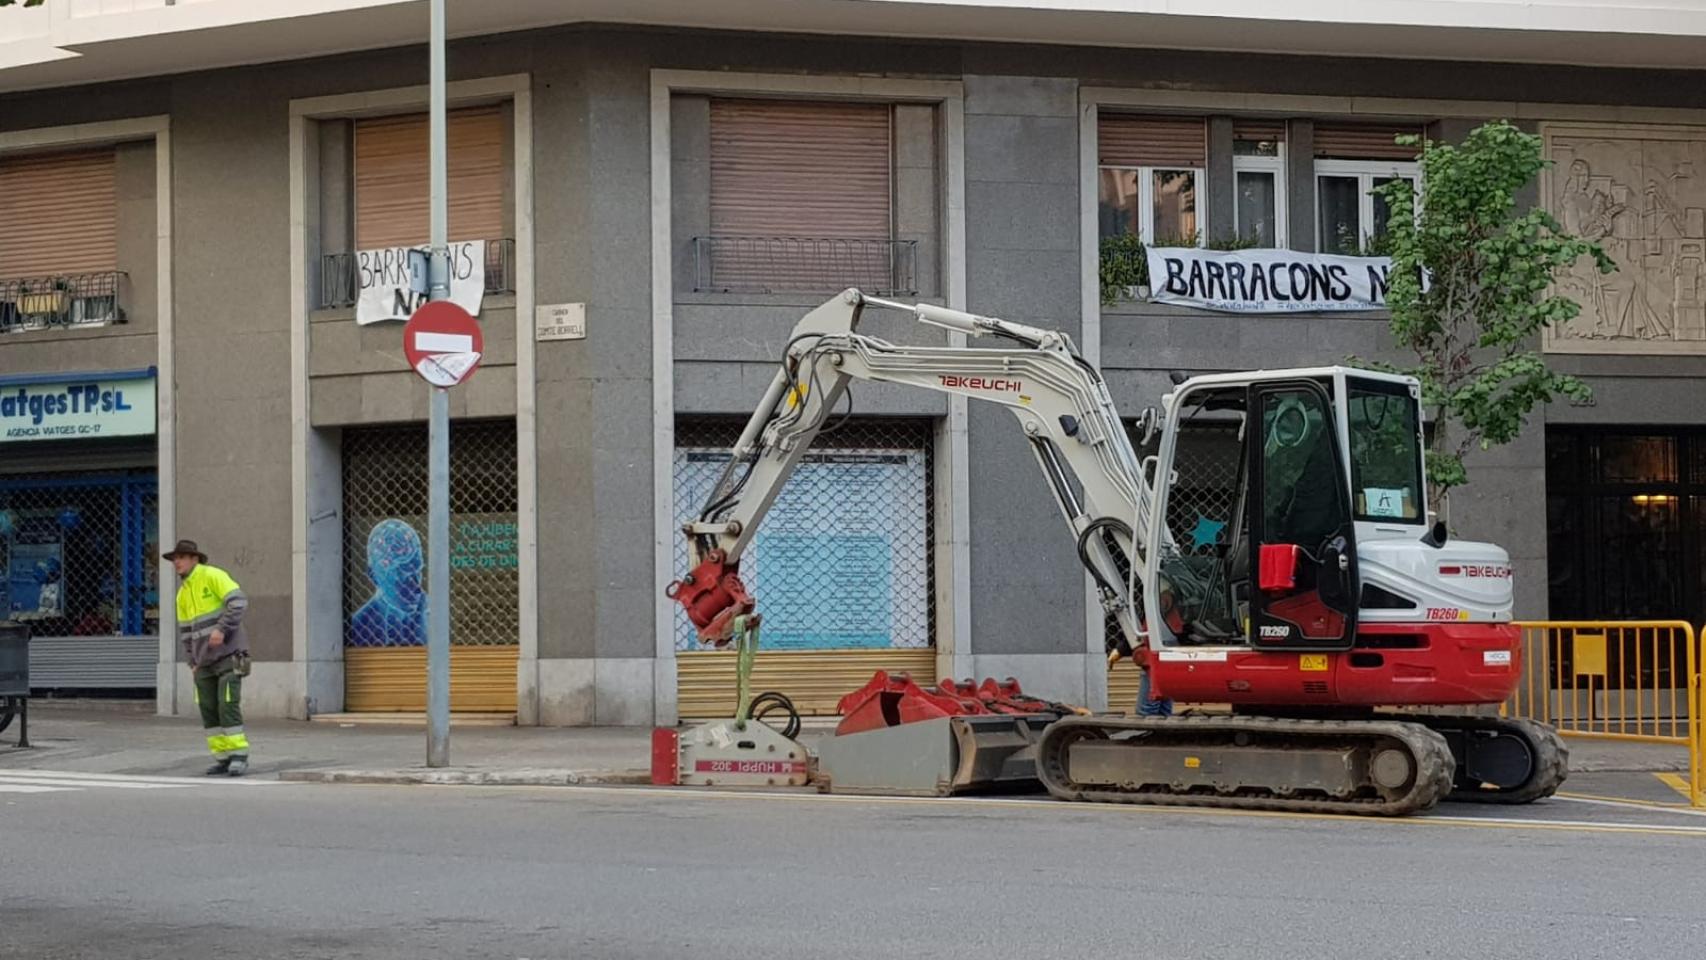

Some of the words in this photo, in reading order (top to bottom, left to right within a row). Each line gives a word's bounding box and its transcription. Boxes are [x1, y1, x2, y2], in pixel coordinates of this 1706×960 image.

[360, 243, 473, 289] BARRNS
[1165, 258, 1352, 301] BARRACONS
[393, 288, 430, 316] N
[938, 375, 1022, 392] TAKEUCHI
[7, 428, 40, 437] AGENCIA
[43, 426, 76, 435] VIATGES
[1426, 608, 1459, 619] TB260
[1260, 626, 1290, 637] TB260
[738, 762, 776, 773] HUPPI
